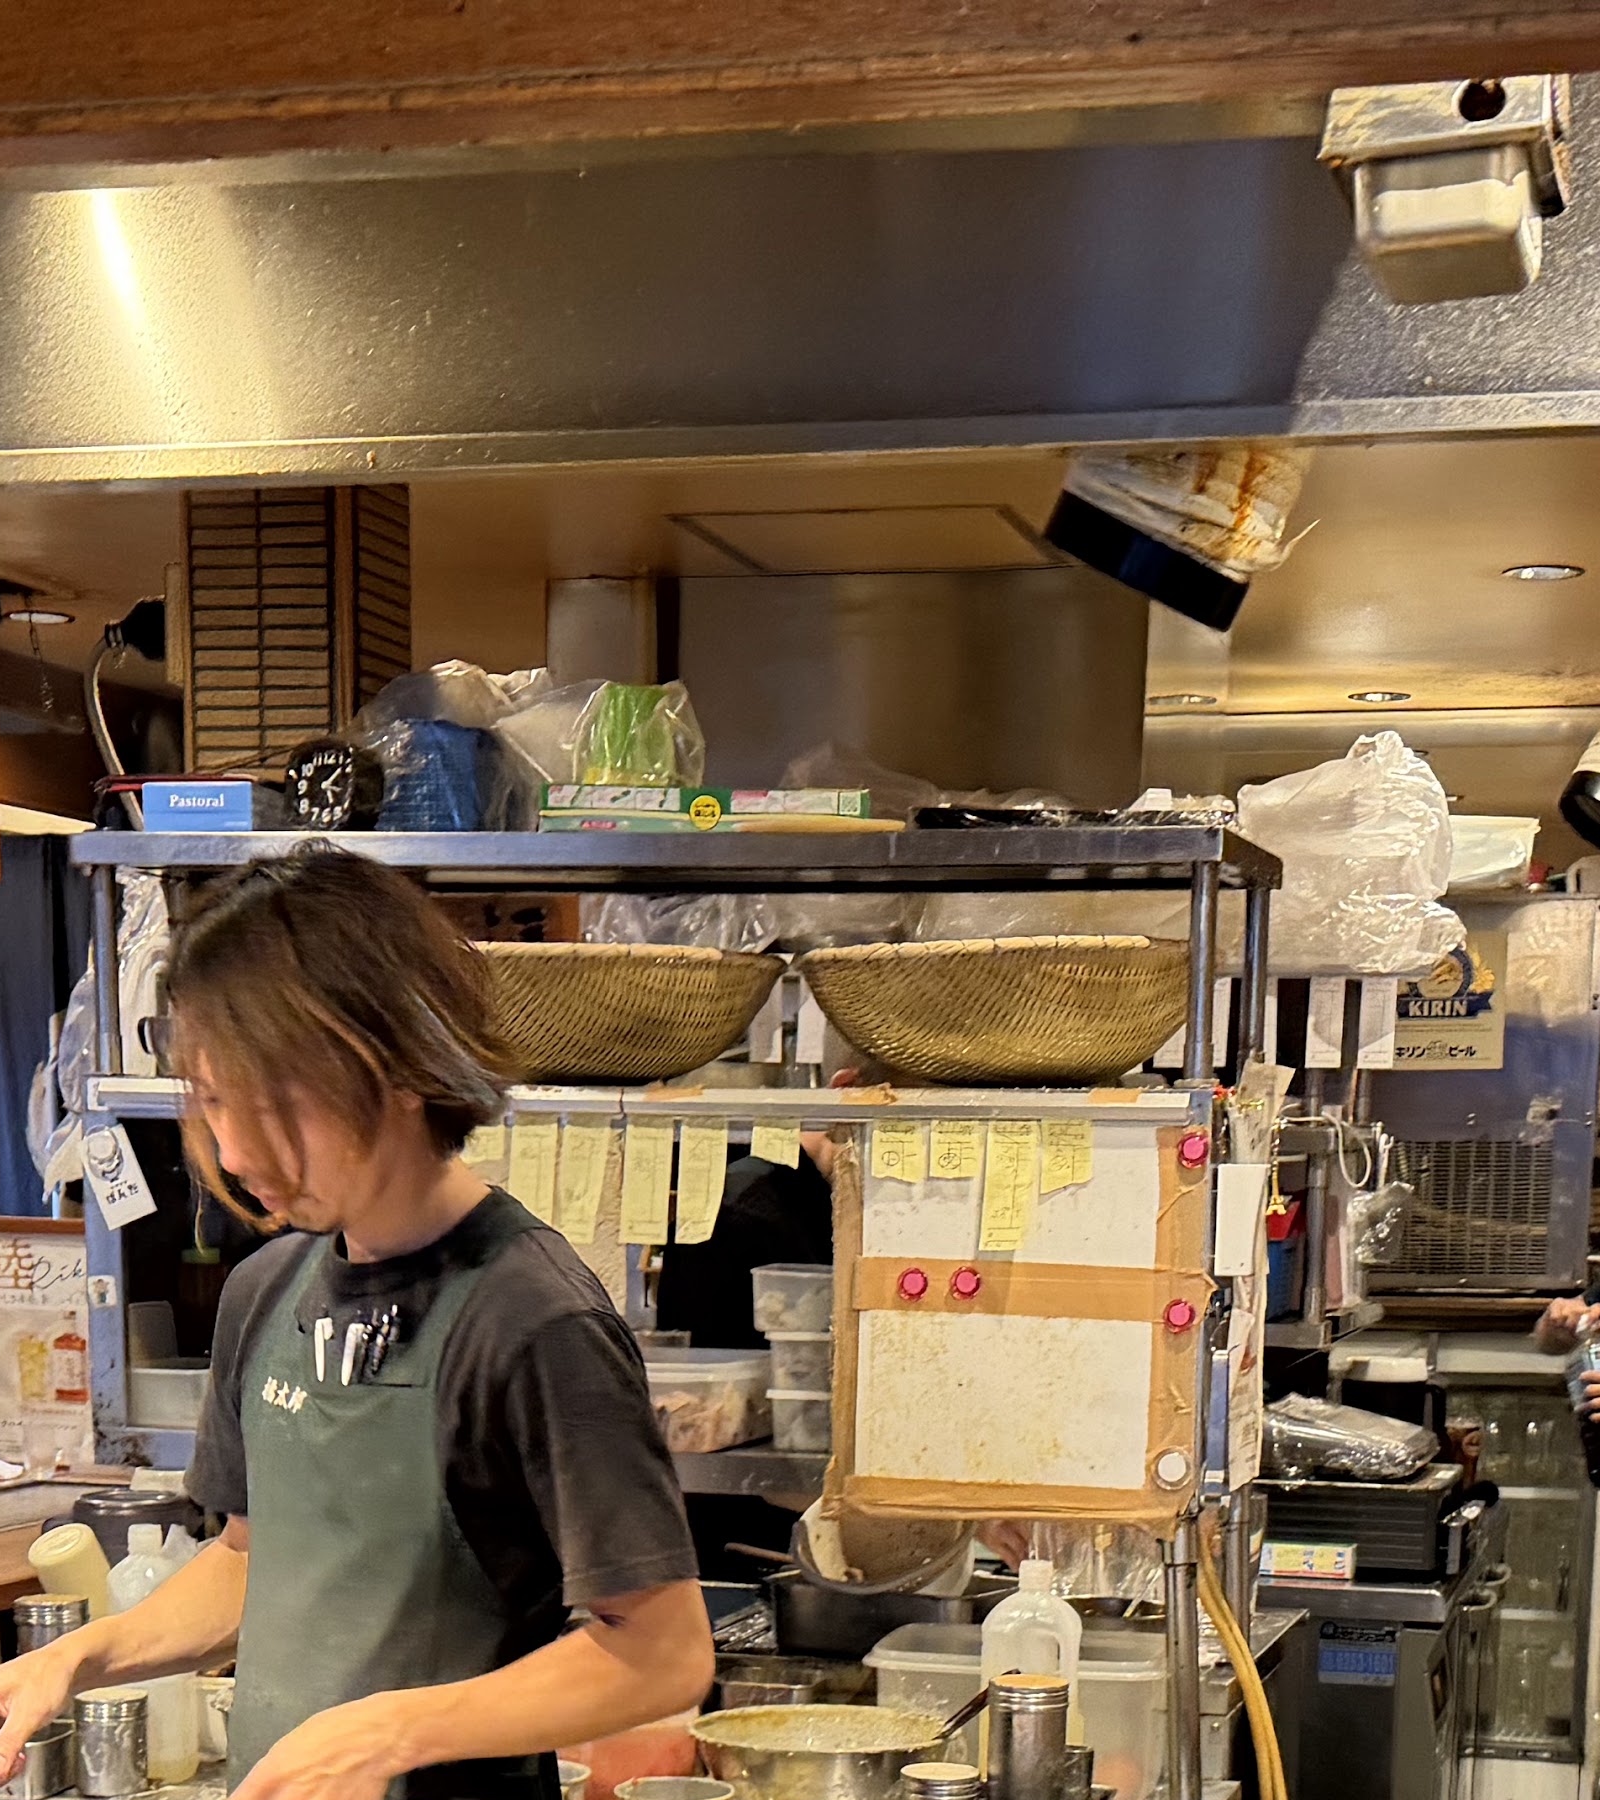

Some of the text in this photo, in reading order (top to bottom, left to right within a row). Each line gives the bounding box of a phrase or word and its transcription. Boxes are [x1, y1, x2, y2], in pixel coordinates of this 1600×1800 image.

[297, 779, 308, 796] 9
[168, 793, 225, 808] Pastoral
[299, 798, 310, 815] 8
[311, 806, 320, 822] 7
[1408, 1000, 1468, 1017] KIRIN
[1448, 1045, 1477, 1058] ビール
[31, 1256, 86, 1290] Rik
